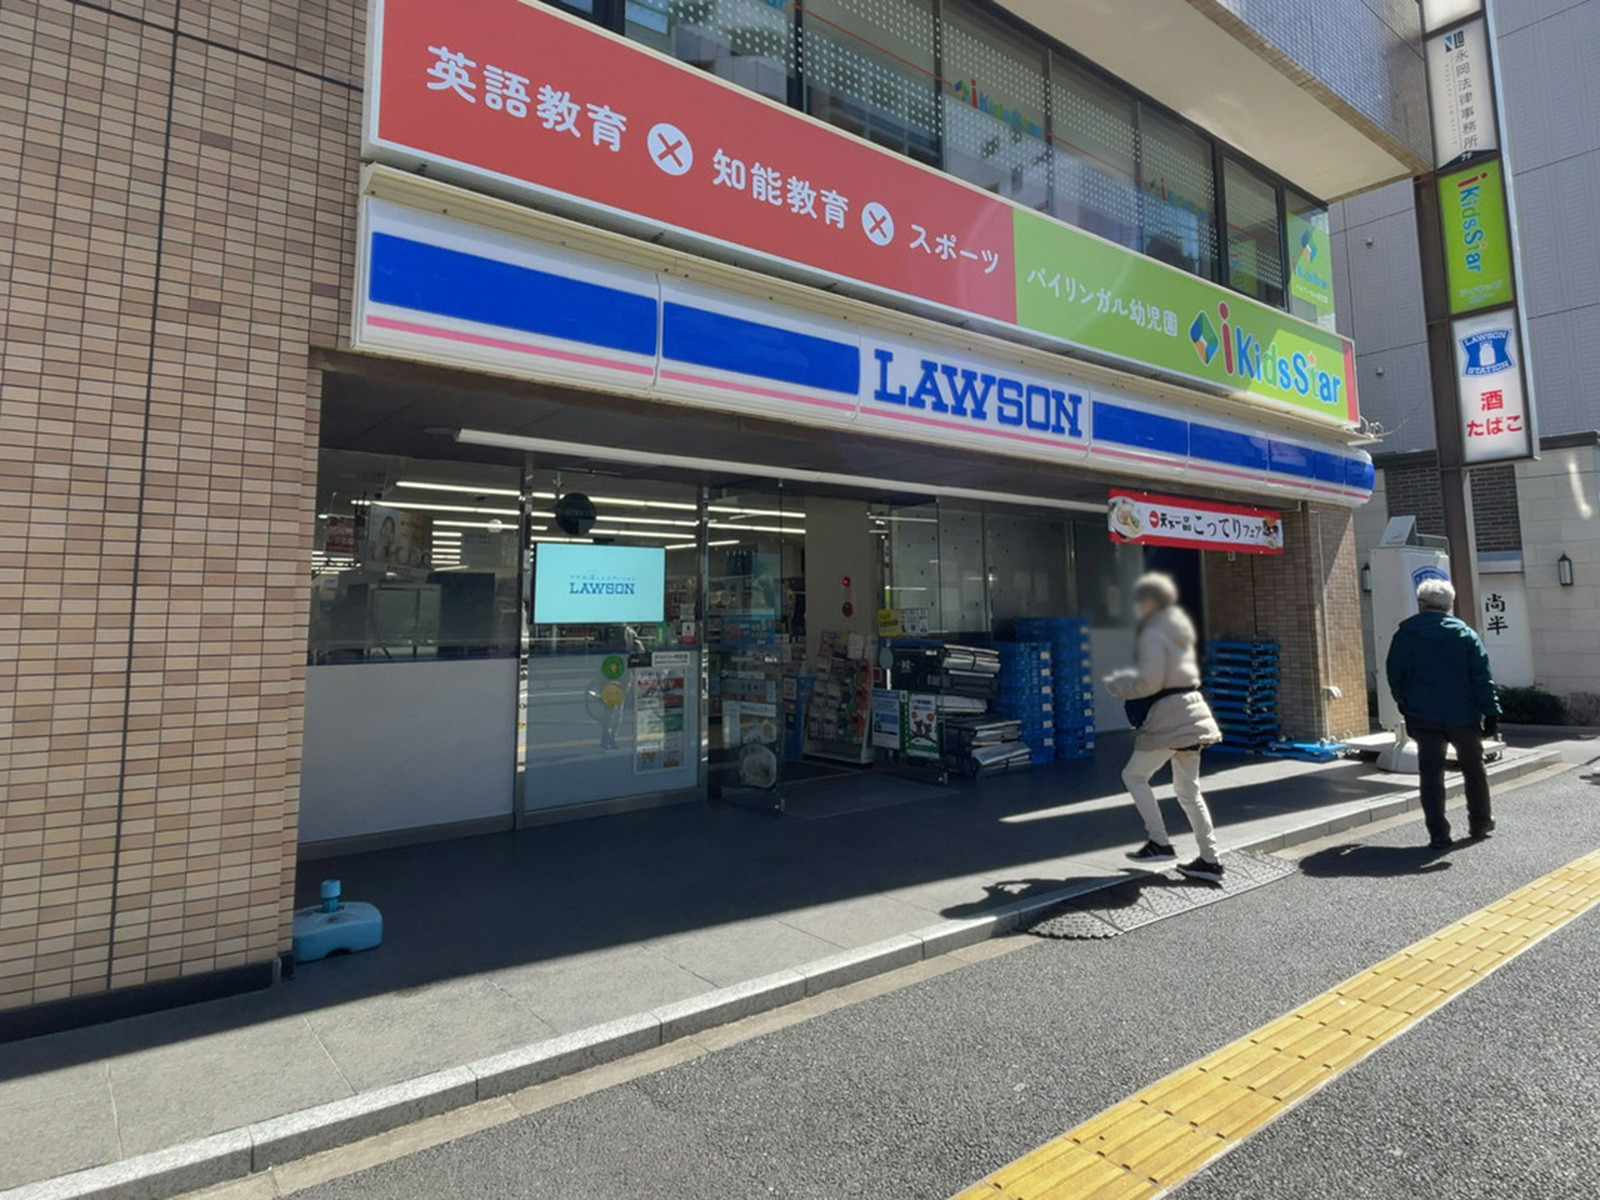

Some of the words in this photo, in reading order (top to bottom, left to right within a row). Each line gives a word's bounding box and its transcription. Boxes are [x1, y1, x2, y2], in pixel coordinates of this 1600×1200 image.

[426, 45, 628, 153] 英語教育
[712, 147, 850, 230] 知能教育
[909, 223, 1000, 275] スポーツ
[1027, 267, 1178, 337] バイリンガル幼児園
[1464, 330, 1507, 347] LAWSON
[1467, 360, 1510, 376] STATION
[873, 348, 1083, 438] LAWSON
[1481, 389, 1503, 411] 酒
[1467, 415, 1522, 437] たばこ
[569, 582, 635, 595] LAWSON
